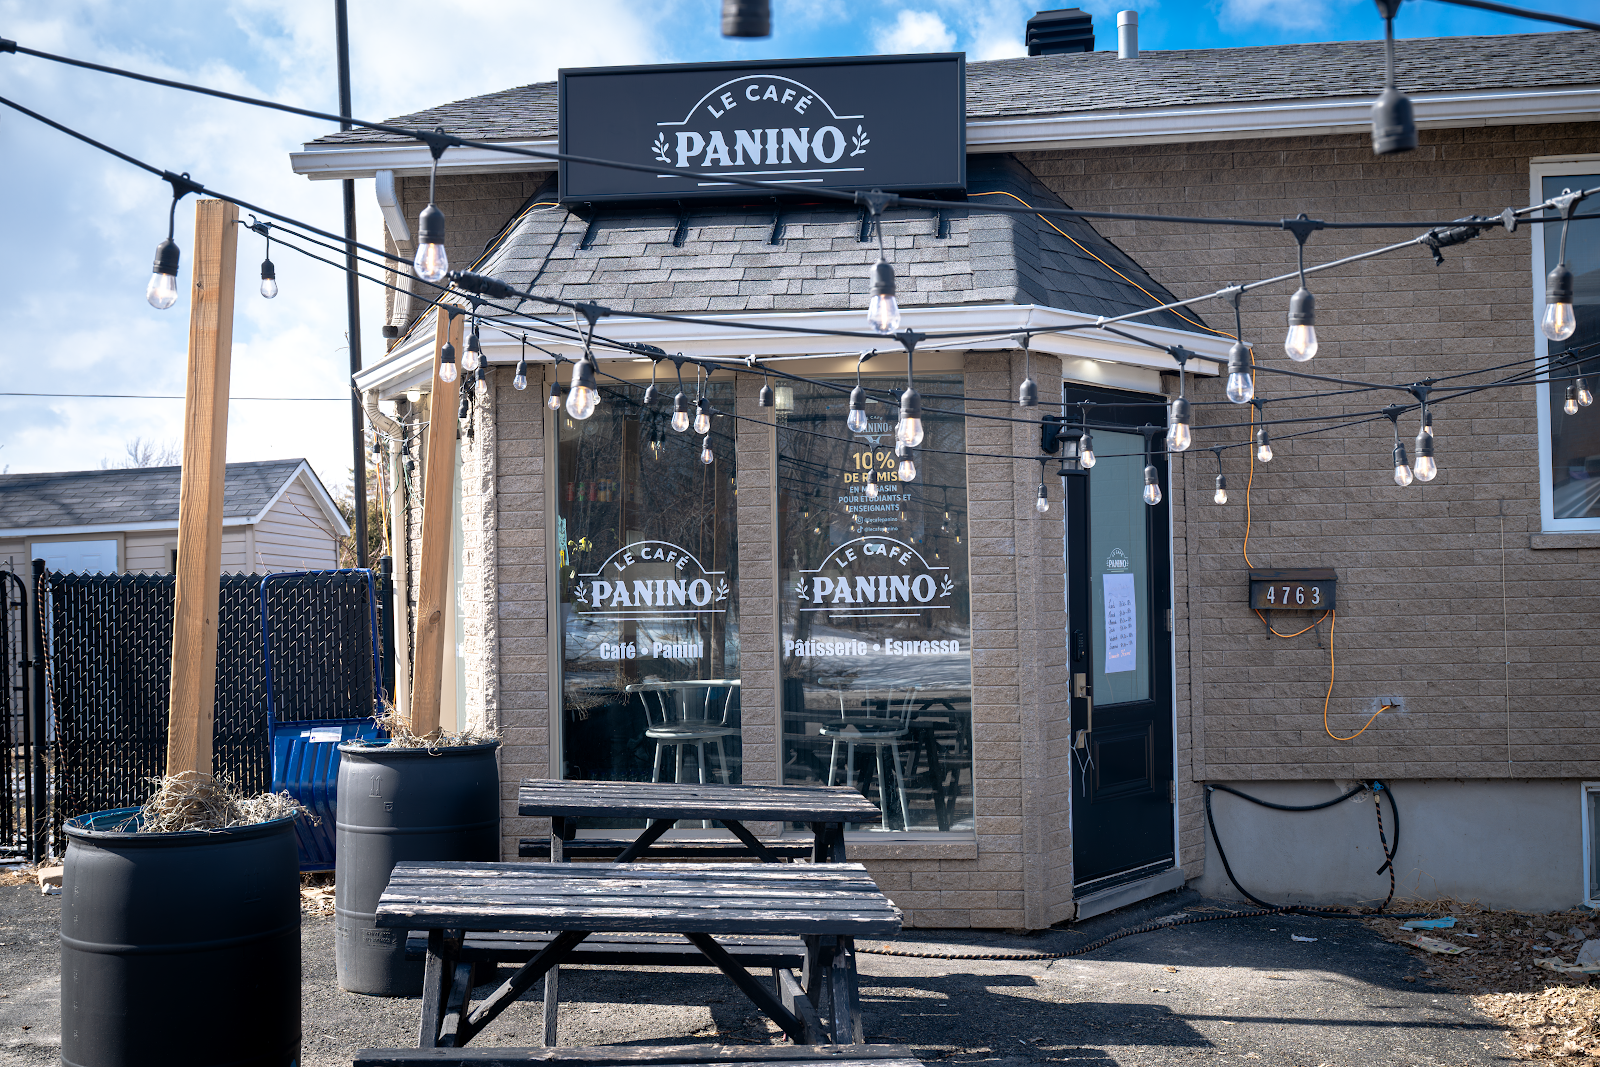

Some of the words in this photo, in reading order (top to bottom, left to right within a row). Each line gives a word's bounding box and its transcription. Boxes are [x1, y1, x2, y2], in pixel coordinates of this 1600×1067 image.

[706, 91, 738, 119] LE
[745, 84, 814, 115] CAFÉ
[675, 125, 847, 168] PANINO
[852, 451, 896, 470] 10%
[843, 472, 860, 483] DE
[862, 471, 903, 482] RMIS
[838, 495, 859, 503] POUR
[902, 493, 912, 501] ET
[849, 485, 860, 493] EN
[861, 484, 898, 493] MASIN
[849, 503, 900, 513] ENSEIGNANTS
[613, 552, 636, 572] LE
[640, 547, 690, 571] CAFÉ
[835, 547, 858, 568] LE
[862, 543, 913, 567] CAFÉ
[591, 578, 713, 607] PANINO
[812, 573, 937, 604] PANINO
[1266, 586, 1320, 605] 4763
[600, 641, 637, 660] Café
[652, 641, 704, 659] Panini
[784, 638, 868, 657] Pâtisserie
[884, 638, 960, 657] Espresso
